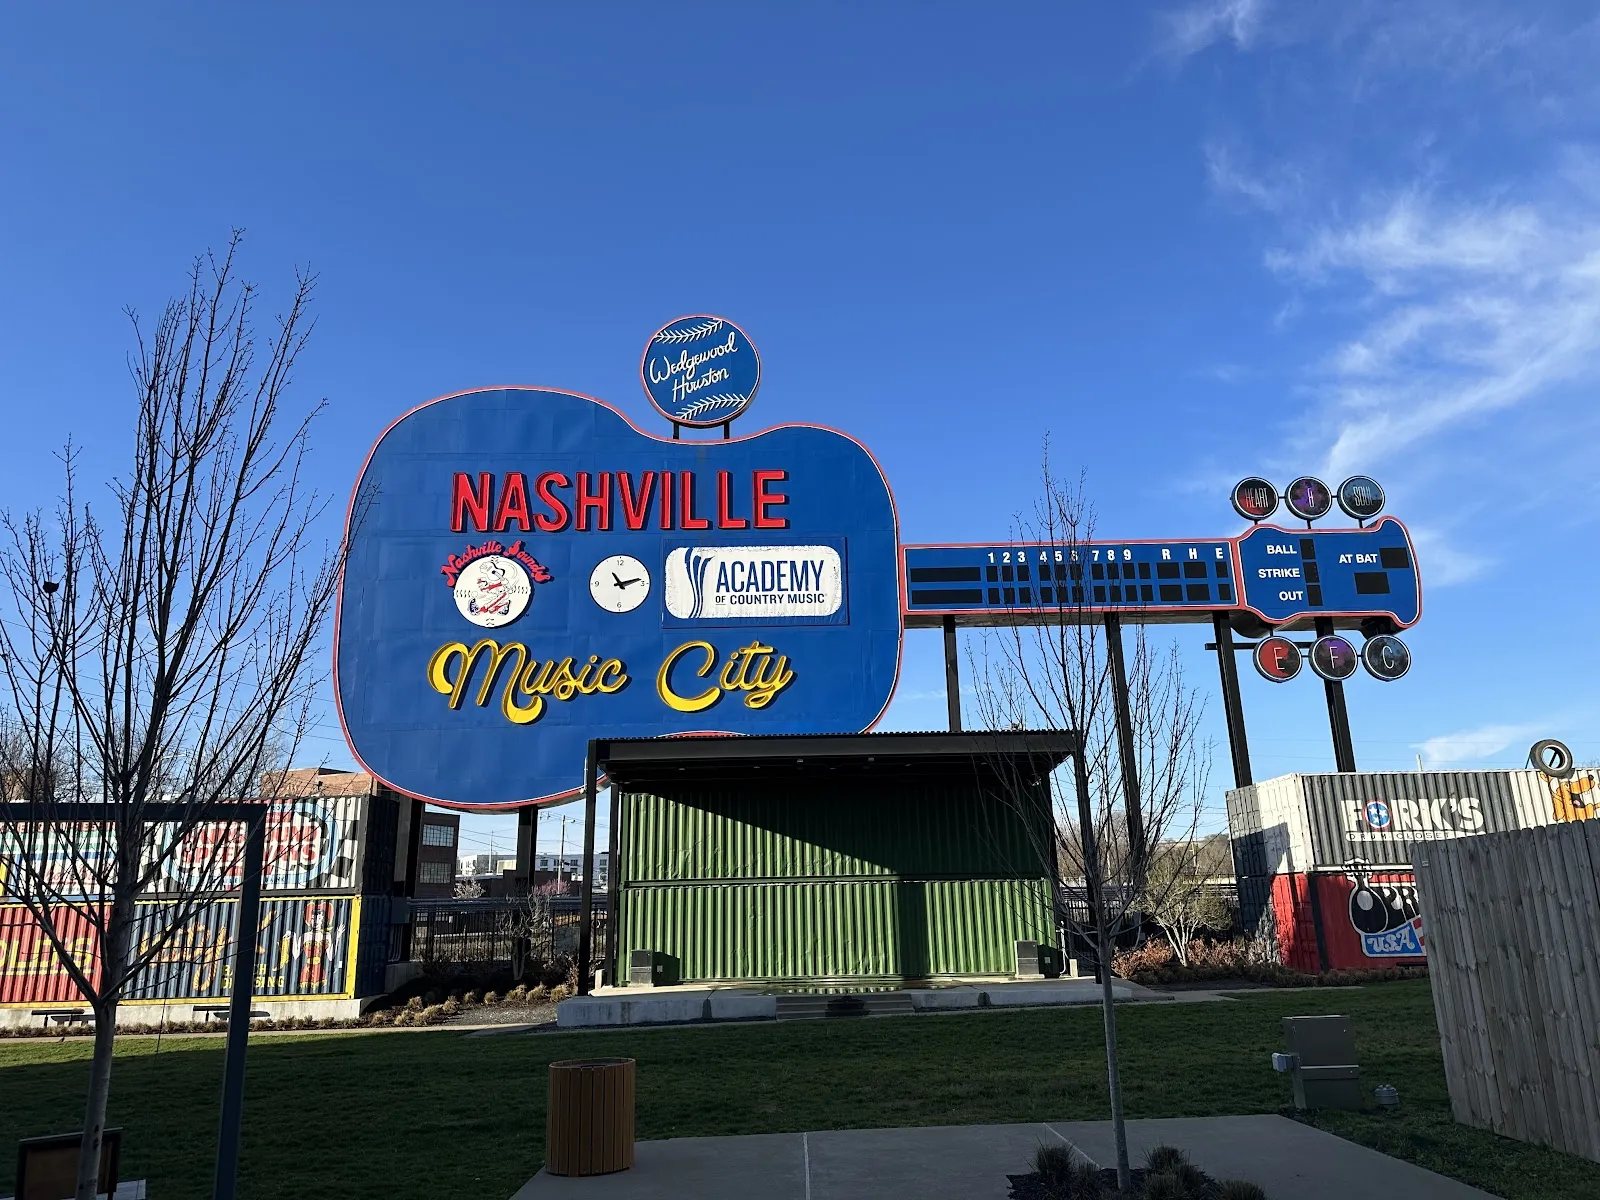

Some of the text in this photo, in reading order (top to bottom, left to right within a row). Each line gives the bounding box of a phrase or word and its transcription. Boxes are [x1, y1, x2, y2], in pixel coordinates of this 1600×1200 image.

[650, 331, 738, 384] Wedgewood
[450, 470, 790, 532] NASHVILLE
[1244, 487, 1269, 508] HEART
[987, 552, 995, 564] 1
[1002, 551, 1011, 563] 2
[1017, 551, 1026, 563] 3
[1040, 551, 1048, 562] 4
[1054, 550, 1063, 562] 5
[1092, 550, 1100, 561] 7
[1107, 549, 1116, 561] 8
[1123, 549, 1132, 560] 9
[1161, 548, 1171, 560] R
[1188, 548, 1198, 559] H
[1215, 547, 1224, 559] E
[1266, 545, 1298, 555] BALL
[1339, 553, 1378, 564] AT BAT
[440, 540, 551, 586] Nashville Sounds
[1258, 568, 1301, 578] STRIKE
[715, 560, 824, 593] ACADEMY
[715, 593, 825, 605] OF COUNTRY MUSIC
[1279, 591, 1304, 601] OUT
[1273, 645, 1395, 670] E F C
[427, 638, 796, 724] Music City
[1349, 832, 1451, 841] DRUM CLOSET
[1367, 926, 1415, 952] USA
